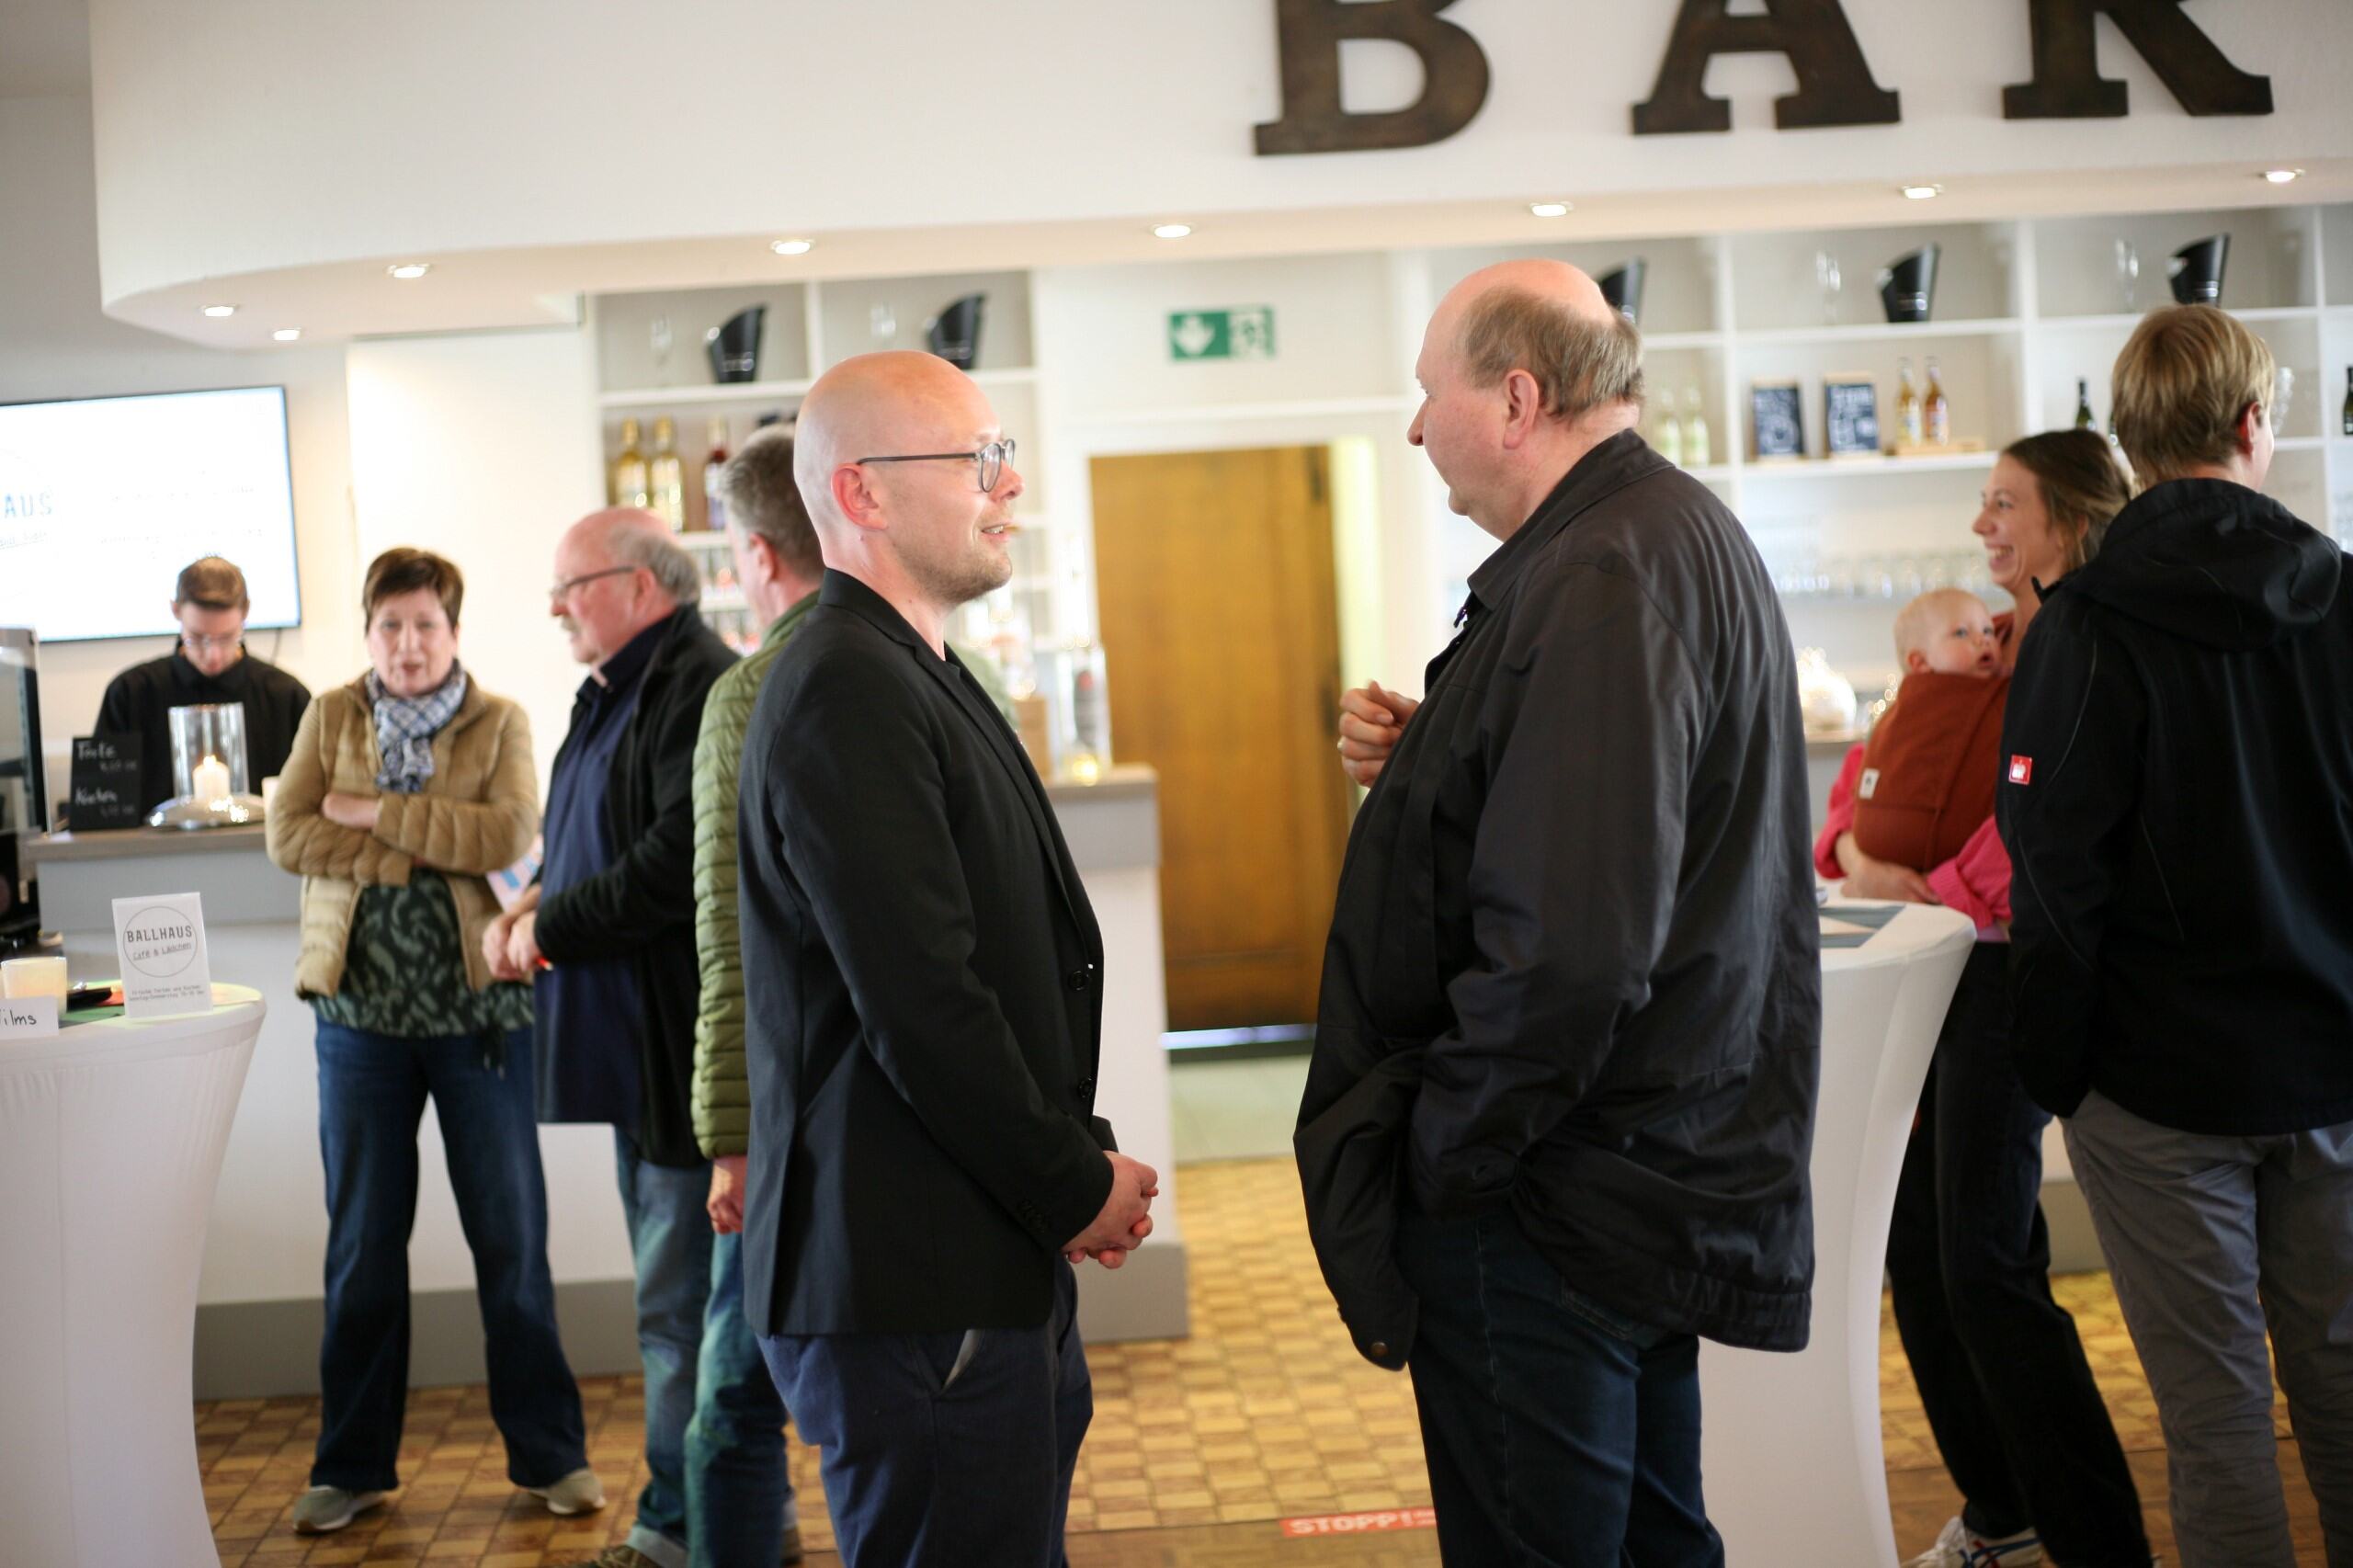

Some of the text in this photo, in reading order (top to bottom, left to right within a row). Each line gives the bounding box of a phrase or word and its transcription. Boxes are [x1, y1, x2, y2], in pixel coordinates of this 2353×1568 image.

[127, 925, 192, 943] BALLHAUS
[0, 1008, 37, 1026] ilms
[1289, 1509, 1414, 1535] STOPP!
